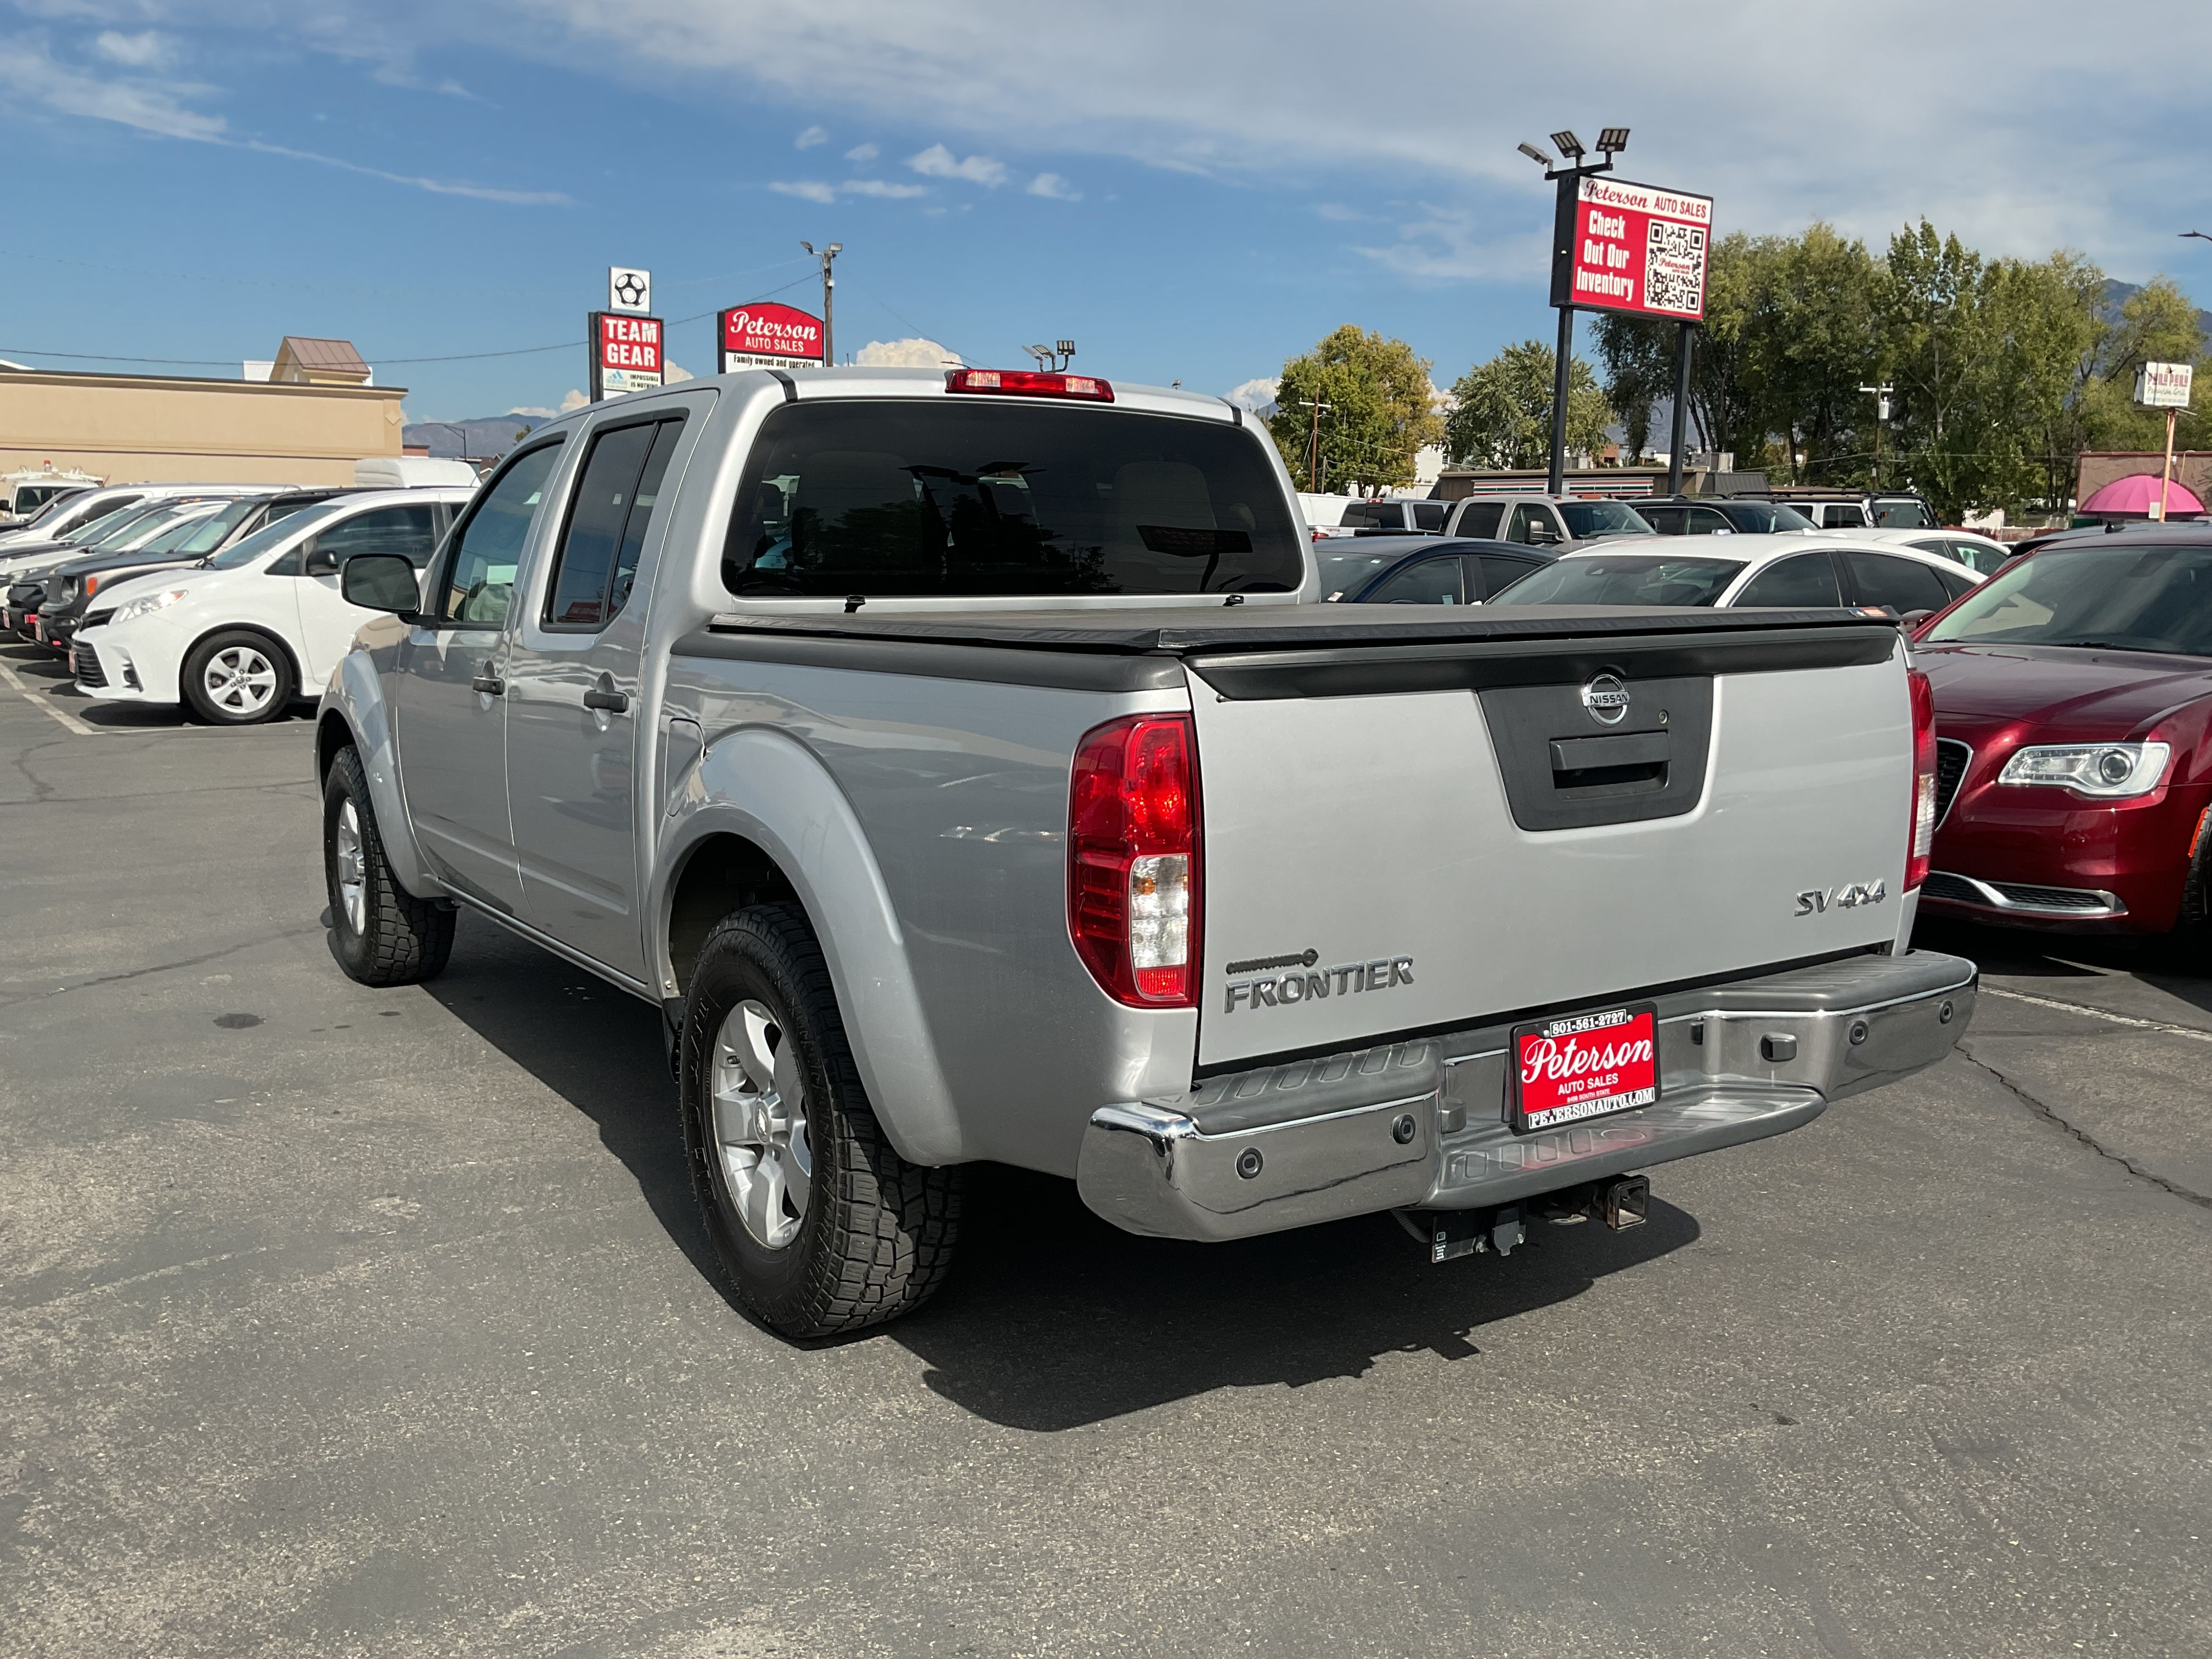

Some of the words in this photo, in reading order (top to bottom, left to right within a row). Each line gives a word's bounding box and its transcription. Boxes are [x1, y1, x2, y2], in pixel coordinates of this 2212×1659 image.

[1583, 180, 1648, 209] Peterson
[1654, 196, 1677, 213] AUTO
[1679, 200, 1707, 218] SALES
[1589, 210, 1626, 240] Check
[1583, 239, 1604, 266] Out
[1607, 243, 1629, 269] Our
[1658, 257, 1690, 270] Peterson
[1577, 266, 1634, 301] Inventory
[605, 319, 657, 343] TEAM
[730, 311, 817, 341] Peterson
[607, 343, 656, 367] GEAR
[745, 336, 771, 349] AUTO
[774, 338, 804, 353] SALES
[733, 354, 753, 365] Family
[755, 358, 774, 366] owned
[776, 359, 787, 367] and
[2147, 386, 2172, 396] Peuvian
[2173, 387, 2186, 396] Grill
[2169, 373, 2188, 387] PERU
[1589, 694, 1628, 703] NISSAN
[1794, 887, 1833, 917] SV
[1224, 956, 1414, 1013] FRONTIER
[1552, 1012, 1624, 1034] 801-561-2727
[1521, 1038, 1652, 1084] Peterson
[1558, 1080, 1584, 1096] AUTO
[1587, 1073, 1618, 1089] SALES
[1579, 1092, 1595, 1100] SOUTH
